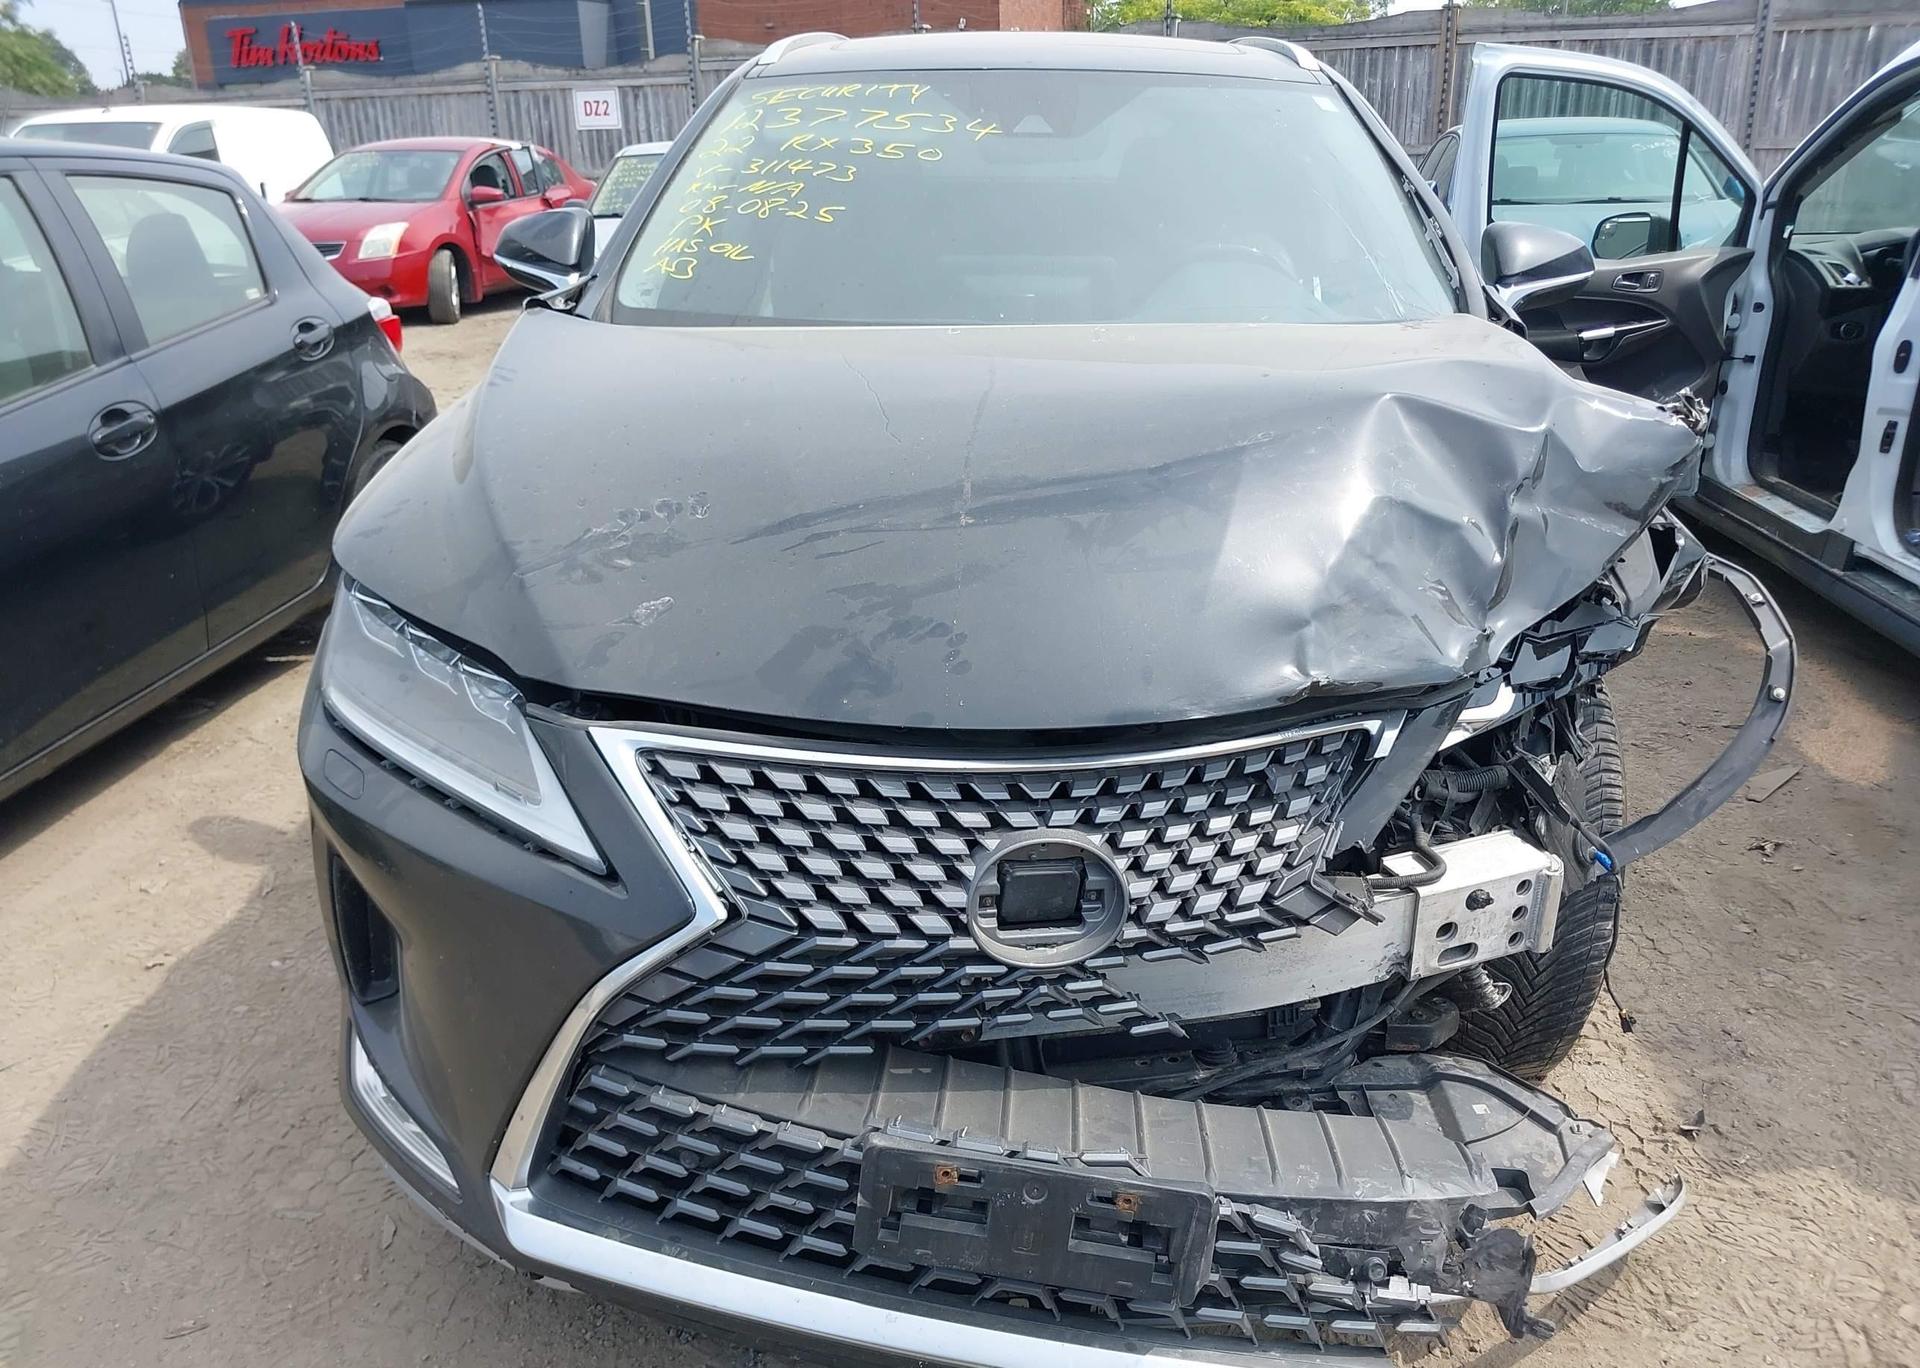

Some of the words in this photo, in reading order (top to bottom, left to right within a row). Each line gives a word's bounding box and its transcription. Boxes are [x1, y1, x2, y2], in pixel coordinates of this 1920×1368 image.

[226, 27, 274, 67] Tim
[277, 22, 379, 64] Hortons
[750, 84, 931, 105] SECURITY
[583, 99, 611, 118] DZ2
[720, 107, 1003, 141] 12377534
